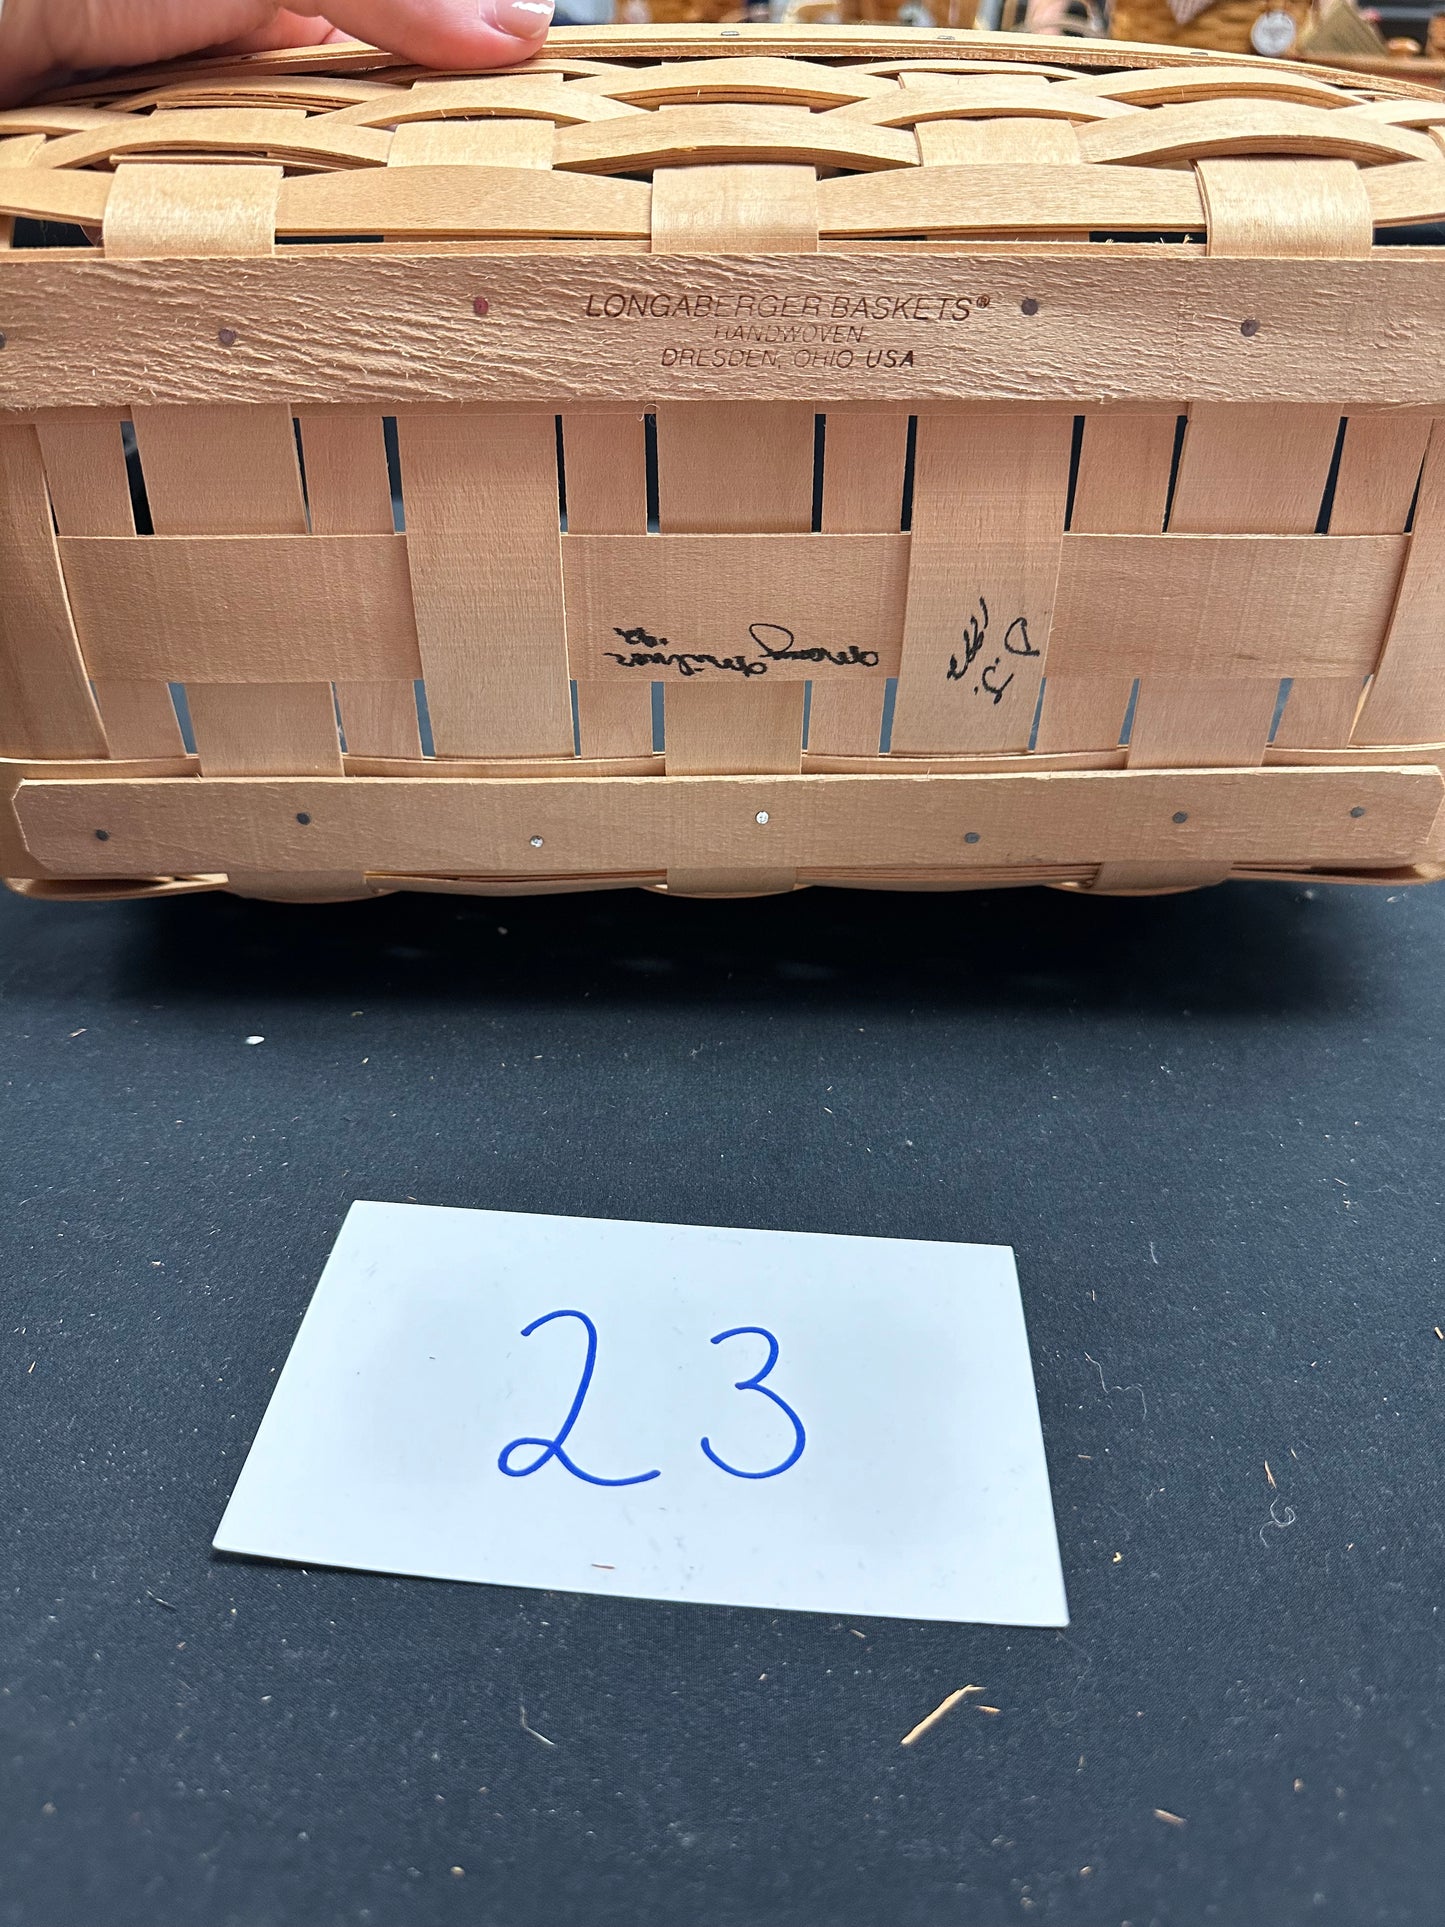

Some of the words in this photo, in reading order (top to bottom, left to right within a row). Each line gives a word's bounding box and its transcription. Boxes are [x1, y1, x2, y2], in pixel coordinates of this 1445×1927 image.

[585, 293, 823, 318] LONGABERGER
[714, 324, 864, 344] HANDWOVEN
[660, 347, 782, 369] DRESDEN,
[793, 348, 854, 369] OHIO
[865, 348, 915, 368] USA
[497, 1309, 806, 1487] 23
